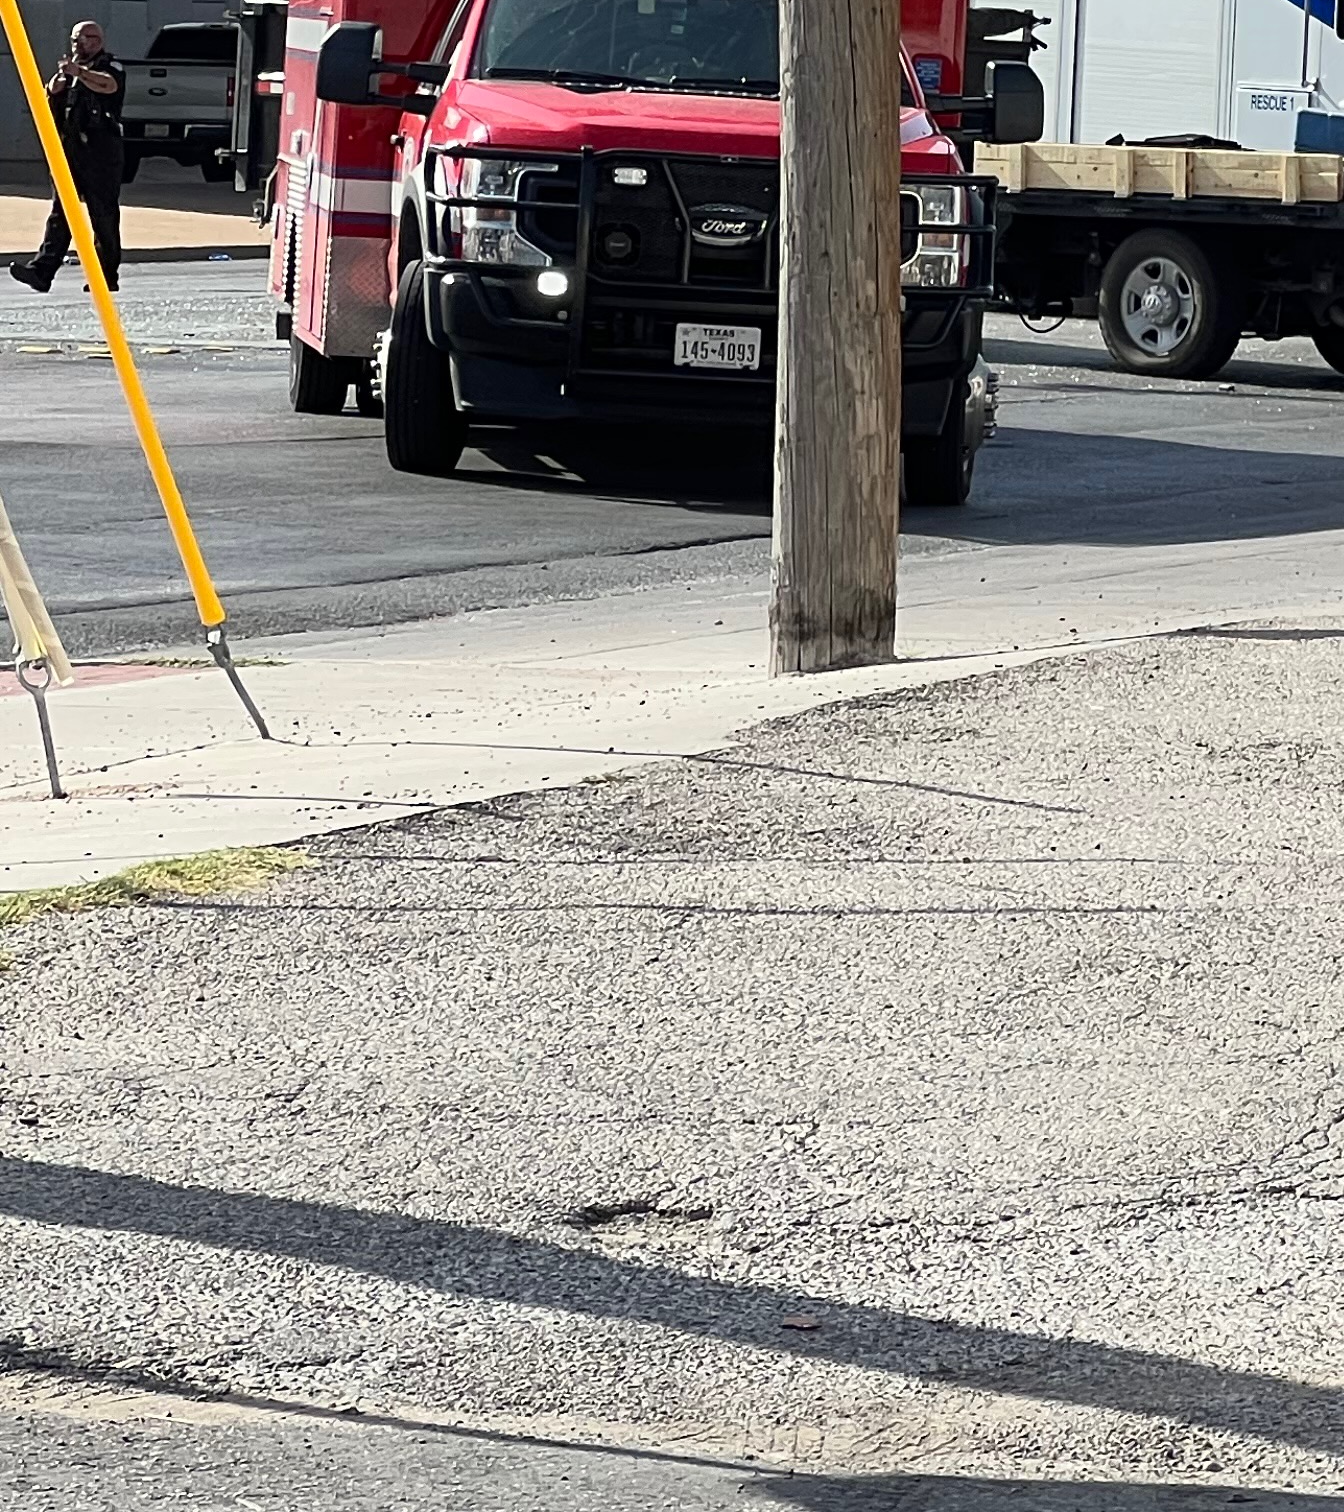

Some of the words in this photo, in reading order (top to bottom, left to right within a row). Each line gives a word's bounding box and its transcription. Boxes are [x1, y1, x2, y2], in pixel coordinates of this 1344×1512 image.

[1251, 95, 1287, 111] RESCUE
[1290, 97, 1295, 111] 1
[701, 219, 746, 234] Ford
[703, 328, 735, 338] TEXAS
